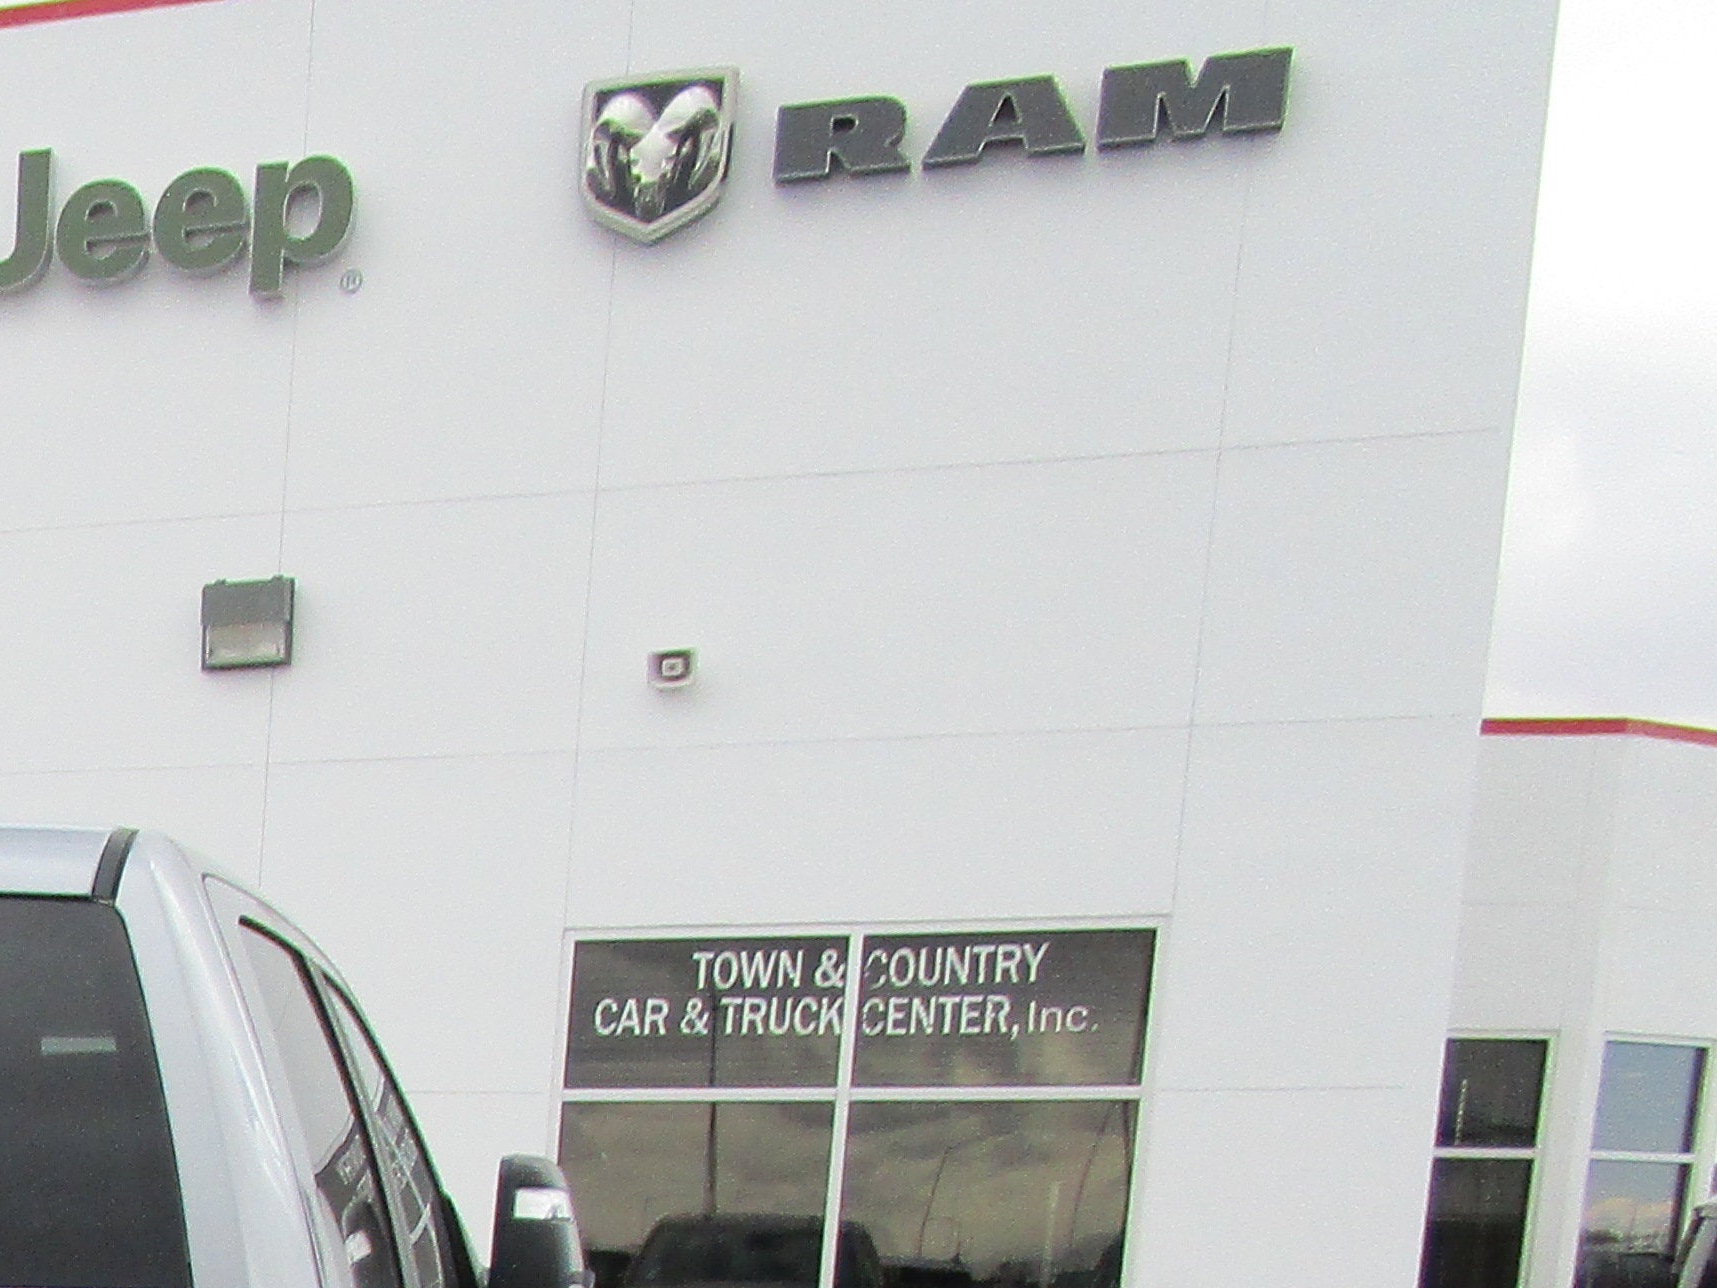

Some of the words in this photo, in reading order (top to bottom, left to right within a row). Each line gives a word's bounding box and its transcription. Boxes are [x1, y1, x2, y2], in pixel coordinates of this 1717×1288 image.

[773, 46, 1295, 184] RAM
[693, 949, 804, 991] TOWN
[813, 948, 846, 989] &
[863, 942, 1050, 989] COUNTRY
[593, 999, 669, 1036] CAR
[679, 999, 709, 1035] &
[719, 996, 844, 1036] TRUCK
[861, 994, 1021, 1041] CENTER,
